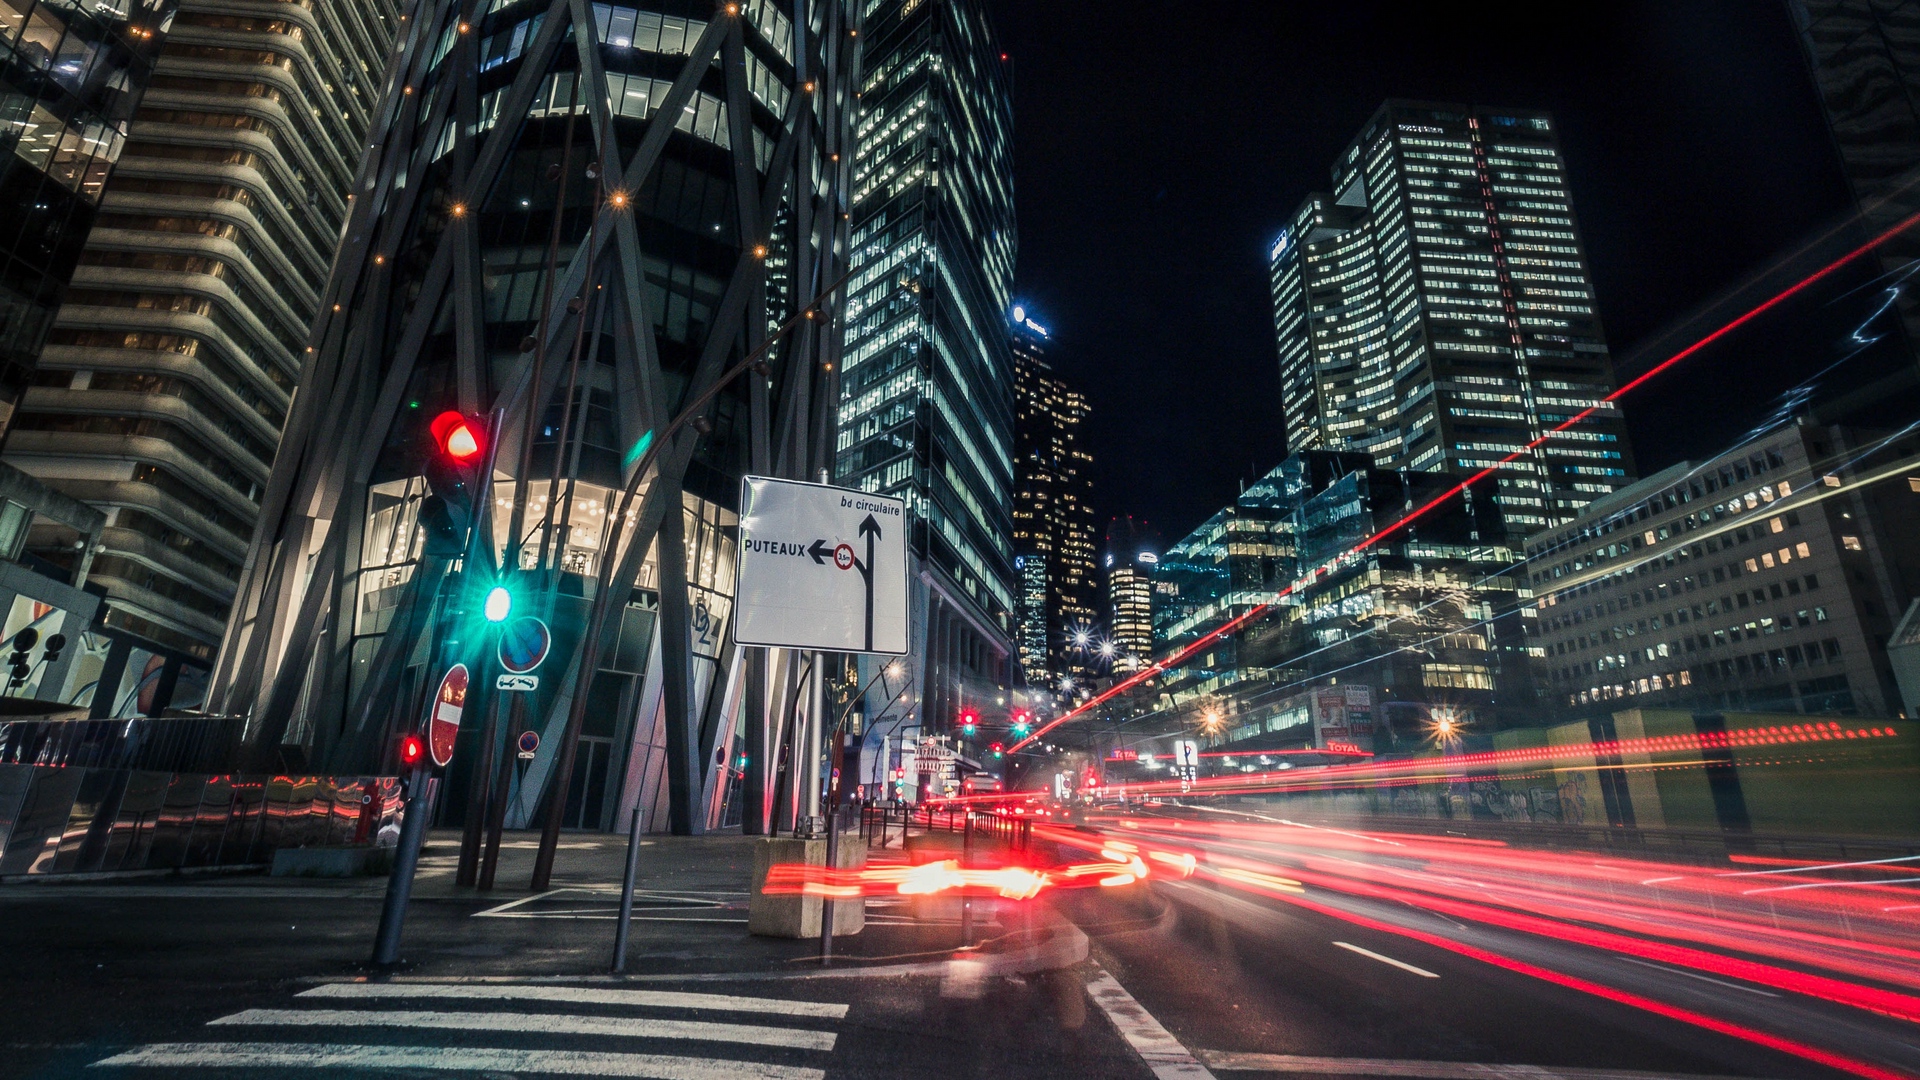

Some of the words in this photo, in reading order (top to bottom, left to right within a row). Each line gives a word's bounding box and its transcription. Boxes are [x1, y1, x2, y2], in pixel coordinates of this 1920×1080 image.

[841, 495, 853, 508] bd
[855, 498, 900, 516] circulaire
[744, 539, 806, 557] PUTEAUX
[1327, 742, 1362, 753] TOTAL
